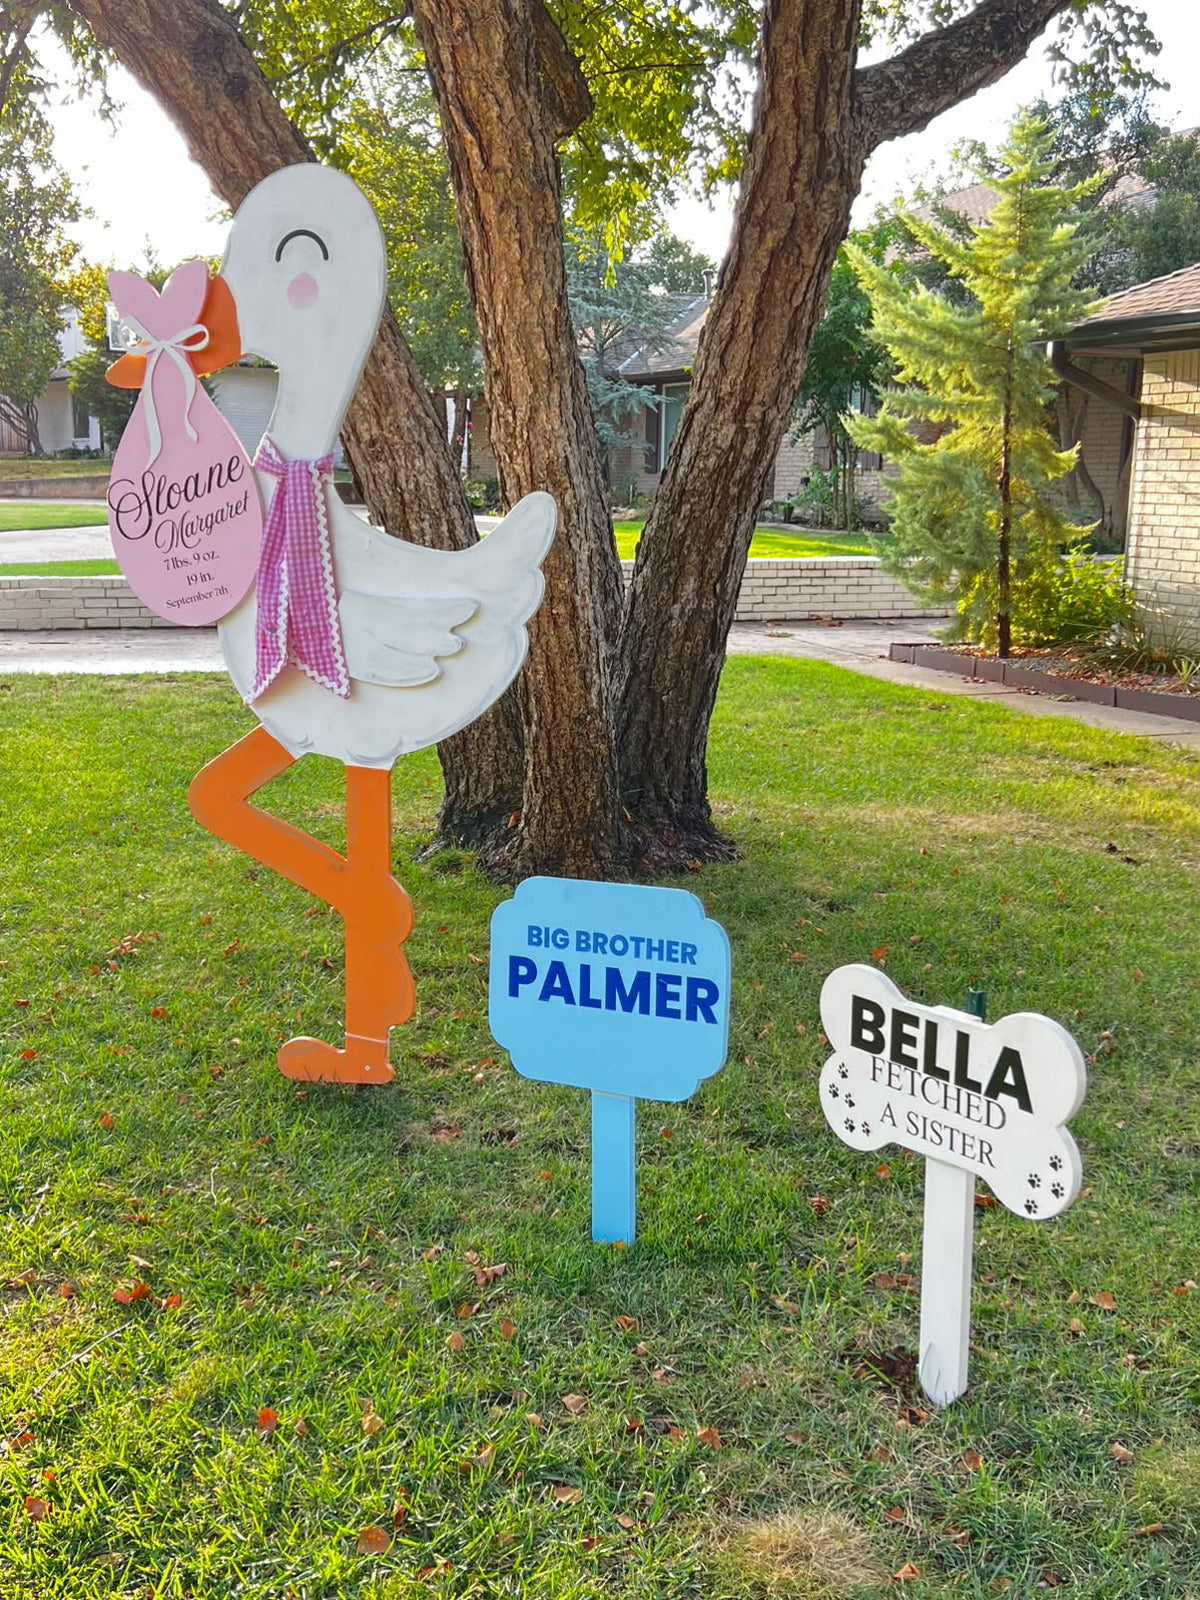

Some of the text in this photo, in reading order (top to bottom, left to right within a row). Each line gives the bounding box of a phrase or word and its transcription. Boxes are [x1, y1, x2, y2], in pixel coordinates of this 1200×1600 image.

[108, 455, 245, 540] Sloane
[154, 490, 250, 554] Margaret
[186, 572, 215, 586] 19 in.
[192, 552, 200, 564] 9
[202, 550, 220, 561] oz.
[165, 585, 229, 609] September 7th
[527, 925, 698, 965] BIG BROTHER
[508, 955, 720, 1025] PALMER
[850, 994, 1034, 1115] BELLA
[870, 1055, 1007, 1130] FETCHED
[879, 1102, 996, 1169] A SISTER
